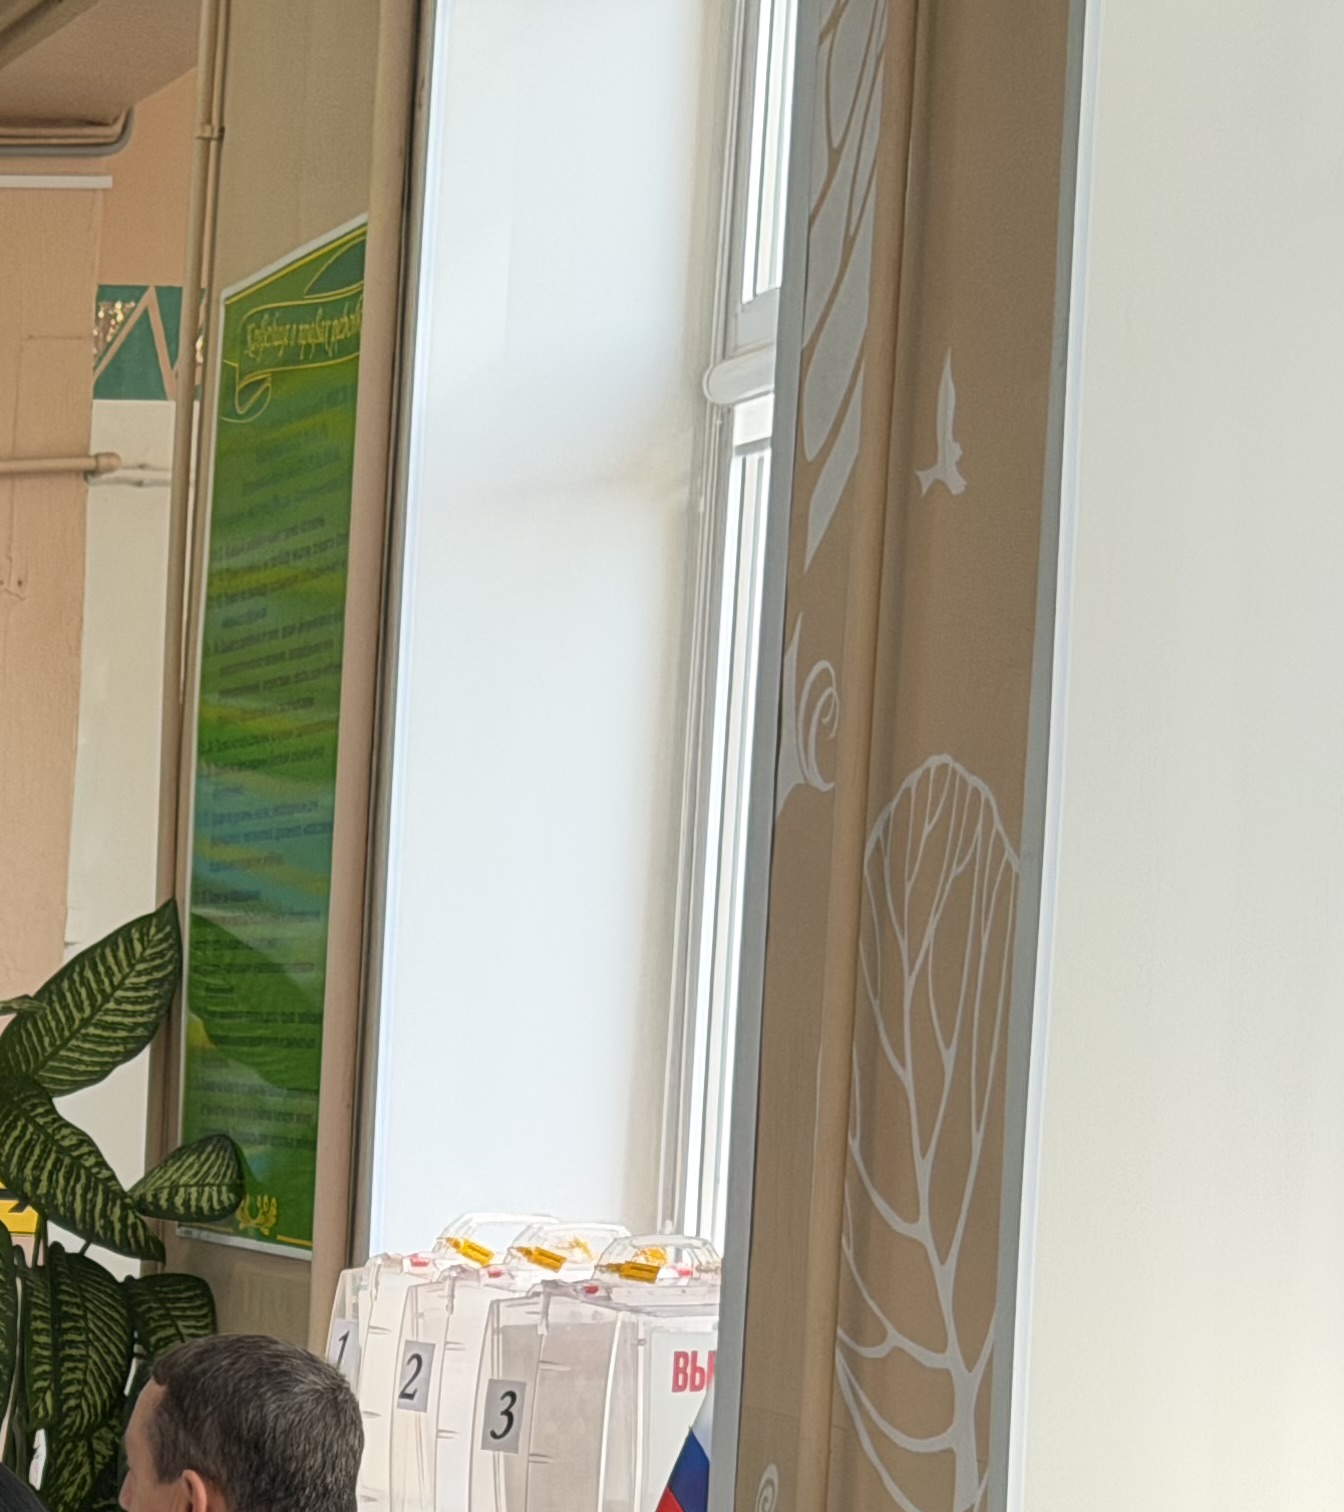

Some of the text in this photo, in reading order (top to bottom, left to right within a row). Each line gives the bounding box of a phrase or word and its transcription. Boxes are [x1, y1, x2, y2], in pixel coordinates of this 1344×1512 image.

[398, 1353, 423, 1401] 2
[671, 1350, 716, 1393] ВЫ
[490, 1390, 517, 1440] 3
